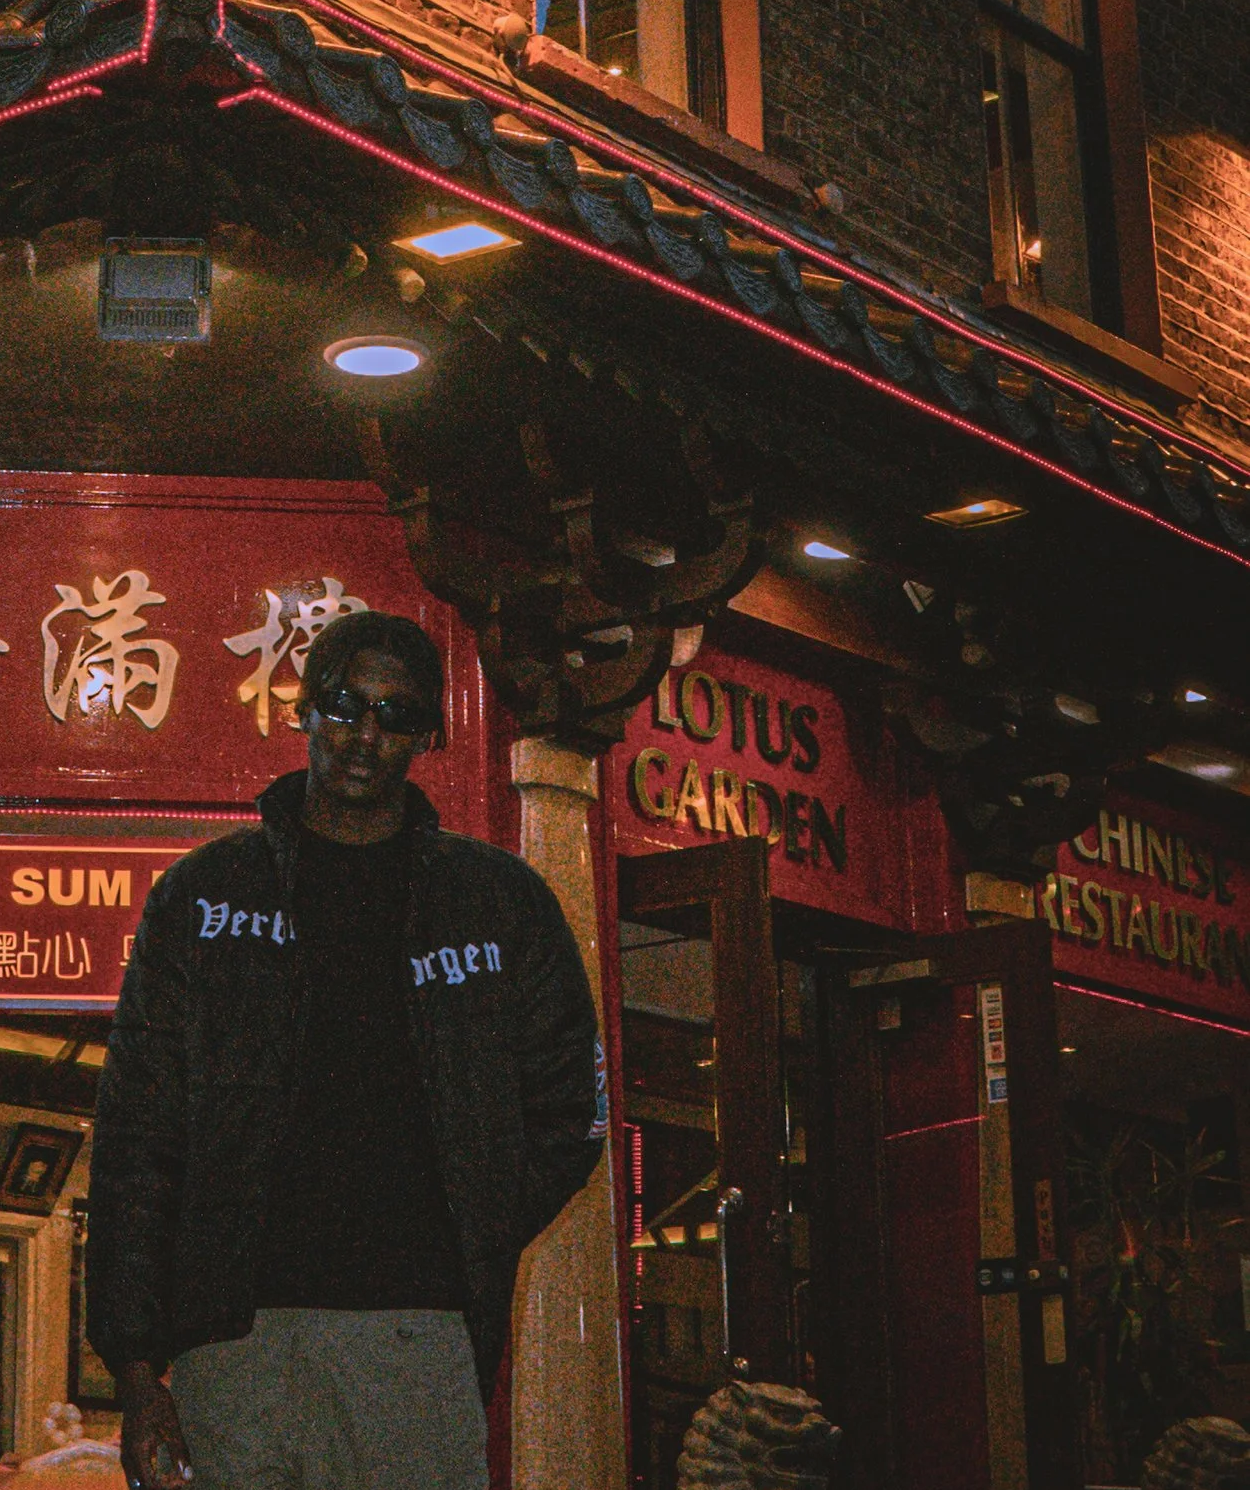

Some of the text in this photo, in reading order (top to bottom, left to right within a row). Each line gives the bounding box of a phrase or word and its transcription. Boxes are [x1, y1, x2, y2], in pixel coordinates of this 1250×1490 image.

[657, 670, 820, 774] LOTUS
[634, 747, 848, 873] GARDEN
[10, 868, 131, 906] SUM
